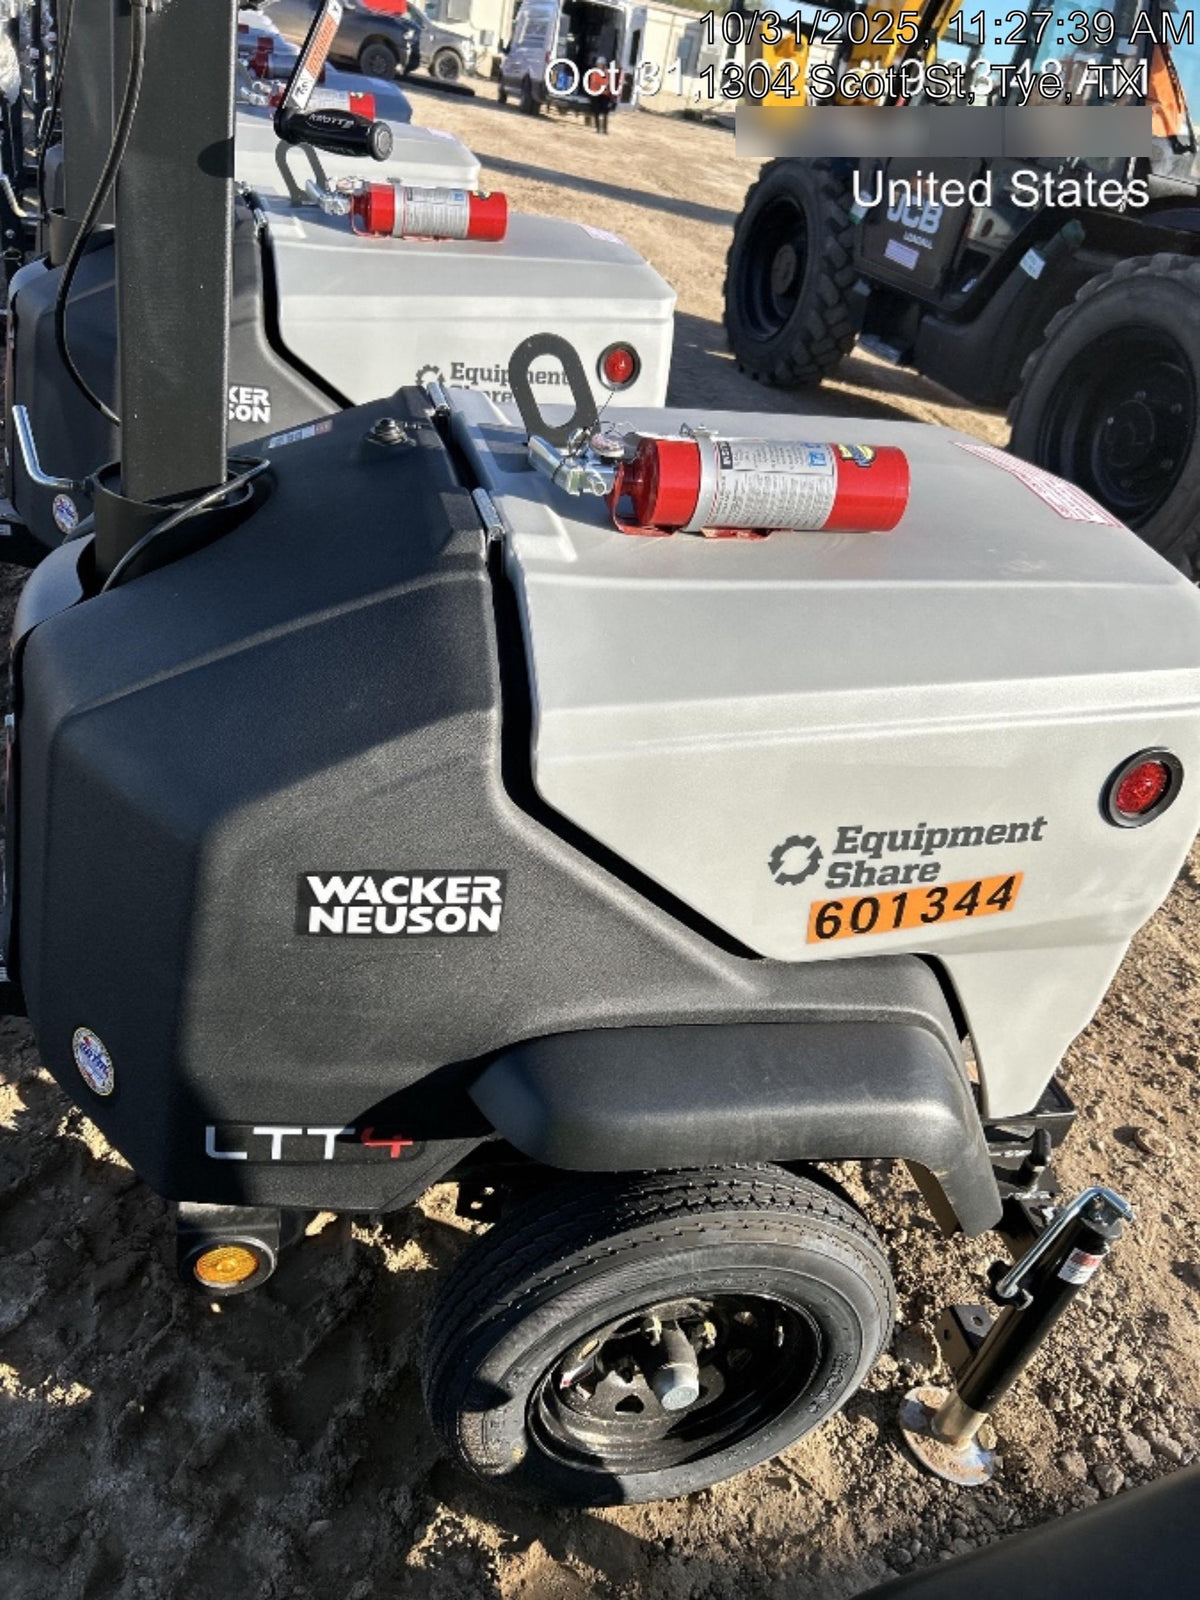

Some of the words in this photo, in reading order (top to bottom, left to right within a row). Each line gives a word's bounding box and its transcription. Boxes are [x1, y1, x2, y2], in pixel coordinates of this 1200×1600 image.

[832, 815, 1048, 859] Equipment
[306, 875, 502, 904] WACKER
[825, 860, 942, 889] Share
[815, 875, 1016, 929] 601344
[308, 904, 502, 934] NEUSON
